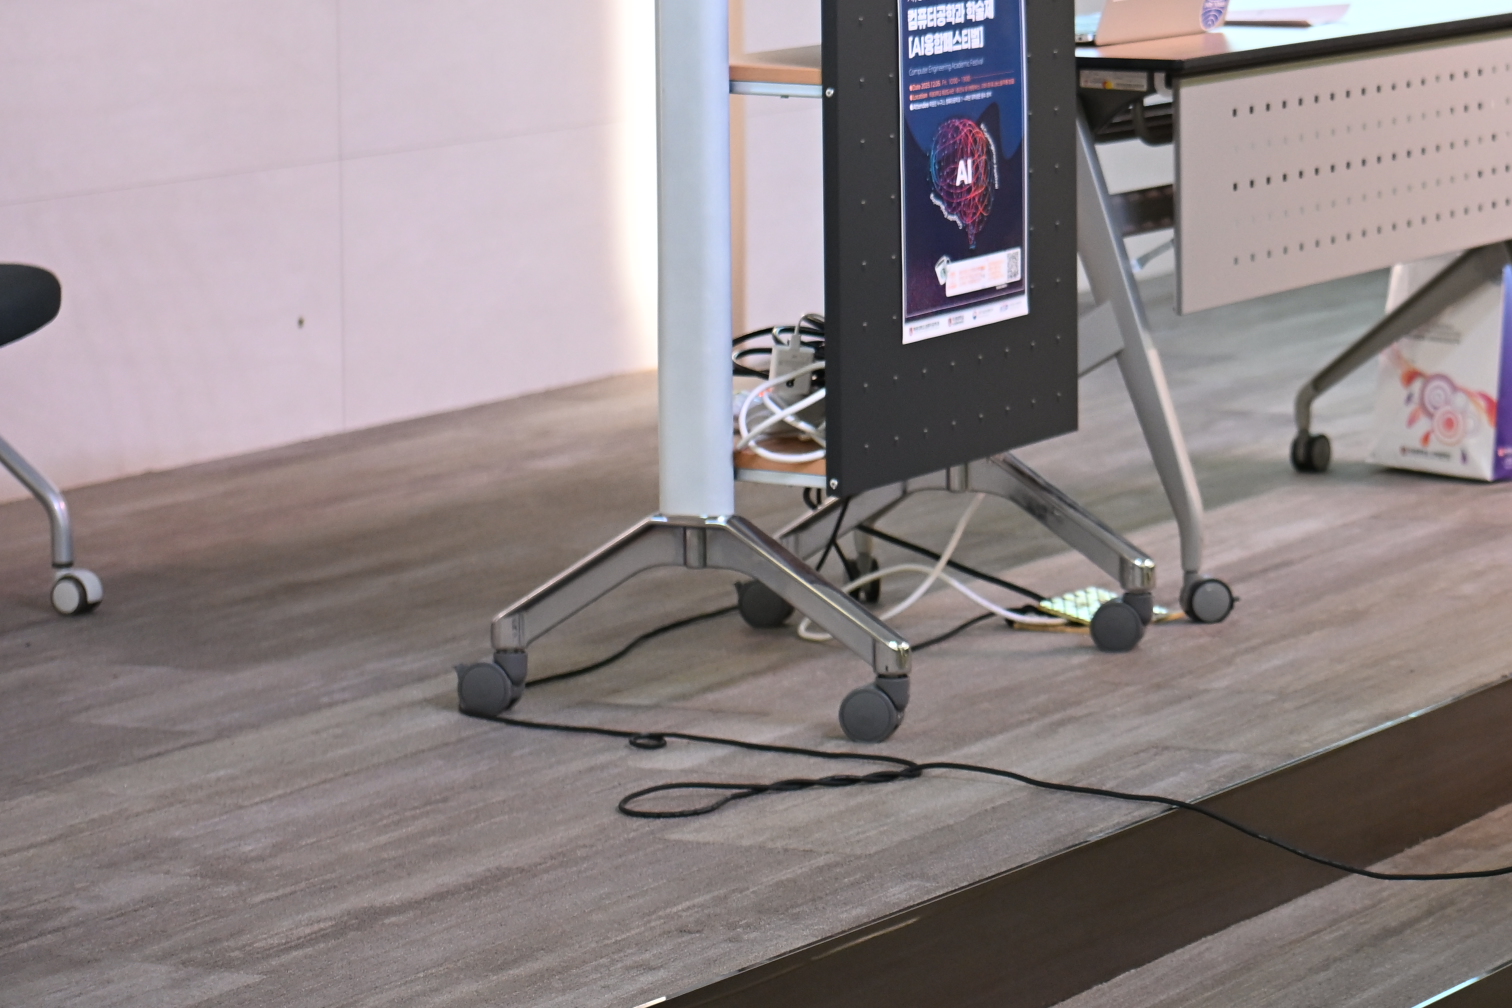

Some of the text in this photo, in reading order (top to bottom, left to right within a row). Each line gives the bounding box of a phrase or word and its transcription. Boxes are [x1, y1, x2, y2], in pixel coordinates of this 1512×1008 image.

[907, 2, 965, 31] 컴퓨터공학과
[908, 27, 984, 59] [AI융합페스티벌]
[956, 158, 973, 186] AI
